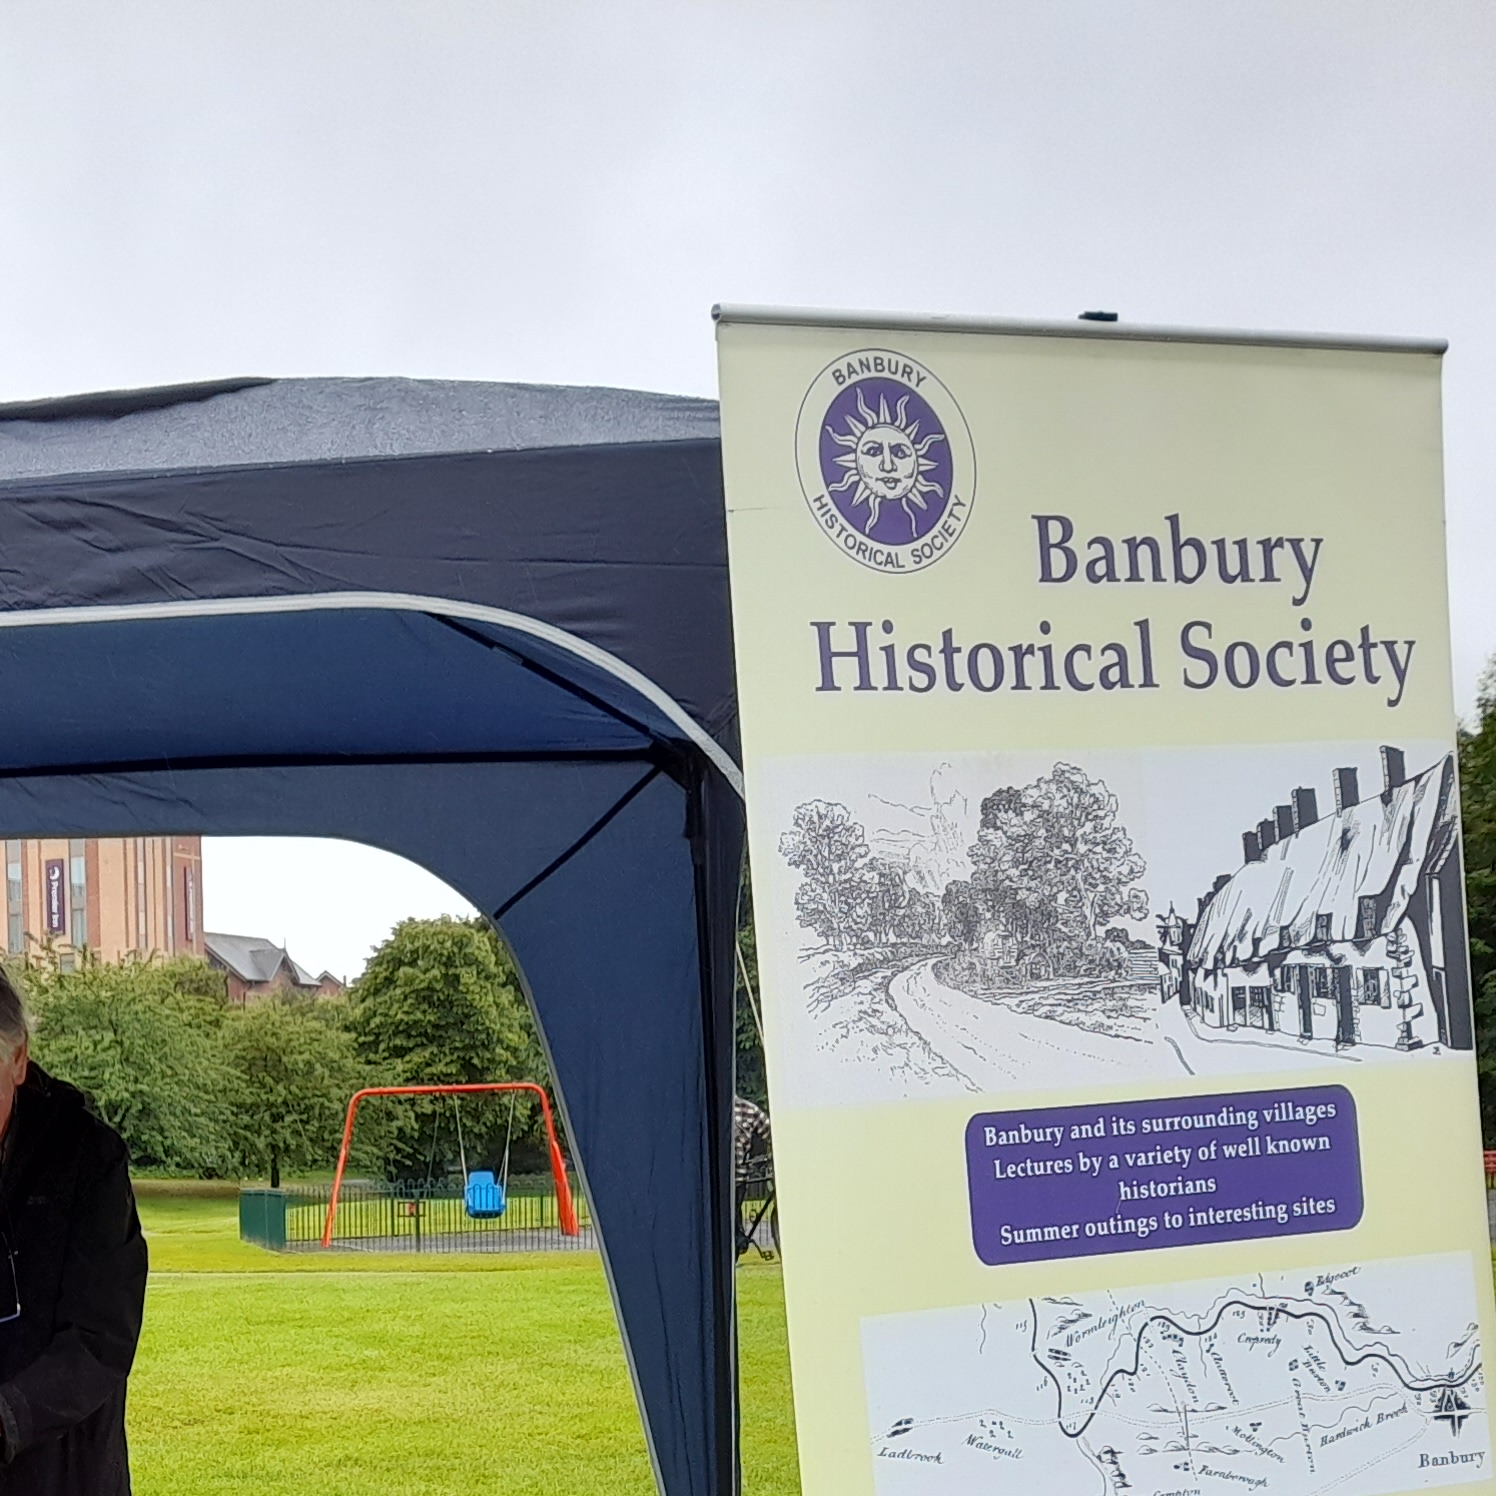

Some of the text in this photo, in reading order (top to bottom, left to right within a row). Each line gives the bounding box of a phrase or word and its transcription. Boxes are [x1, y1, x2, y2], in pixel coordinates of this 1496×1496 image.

[832, 356, 927, 388] BANBURY
[813, 494, 967, 569] HISTORICAL SOCIETY
[1031, 513, 1324, 607] Banbury
[810, 618, 1417, 707] Historical Society
[984, 1102, 1337, 1147] Banbury and its surrounding villages
[994, 1134, 1330, 1179] Lectures by a variety of well known
[1119, 1176, 1217, 1200] historians
[1000, 1196, 1336, 1246] Summer outings to interesting sites
[1417, 1451, 1486, 1469] Banbury
